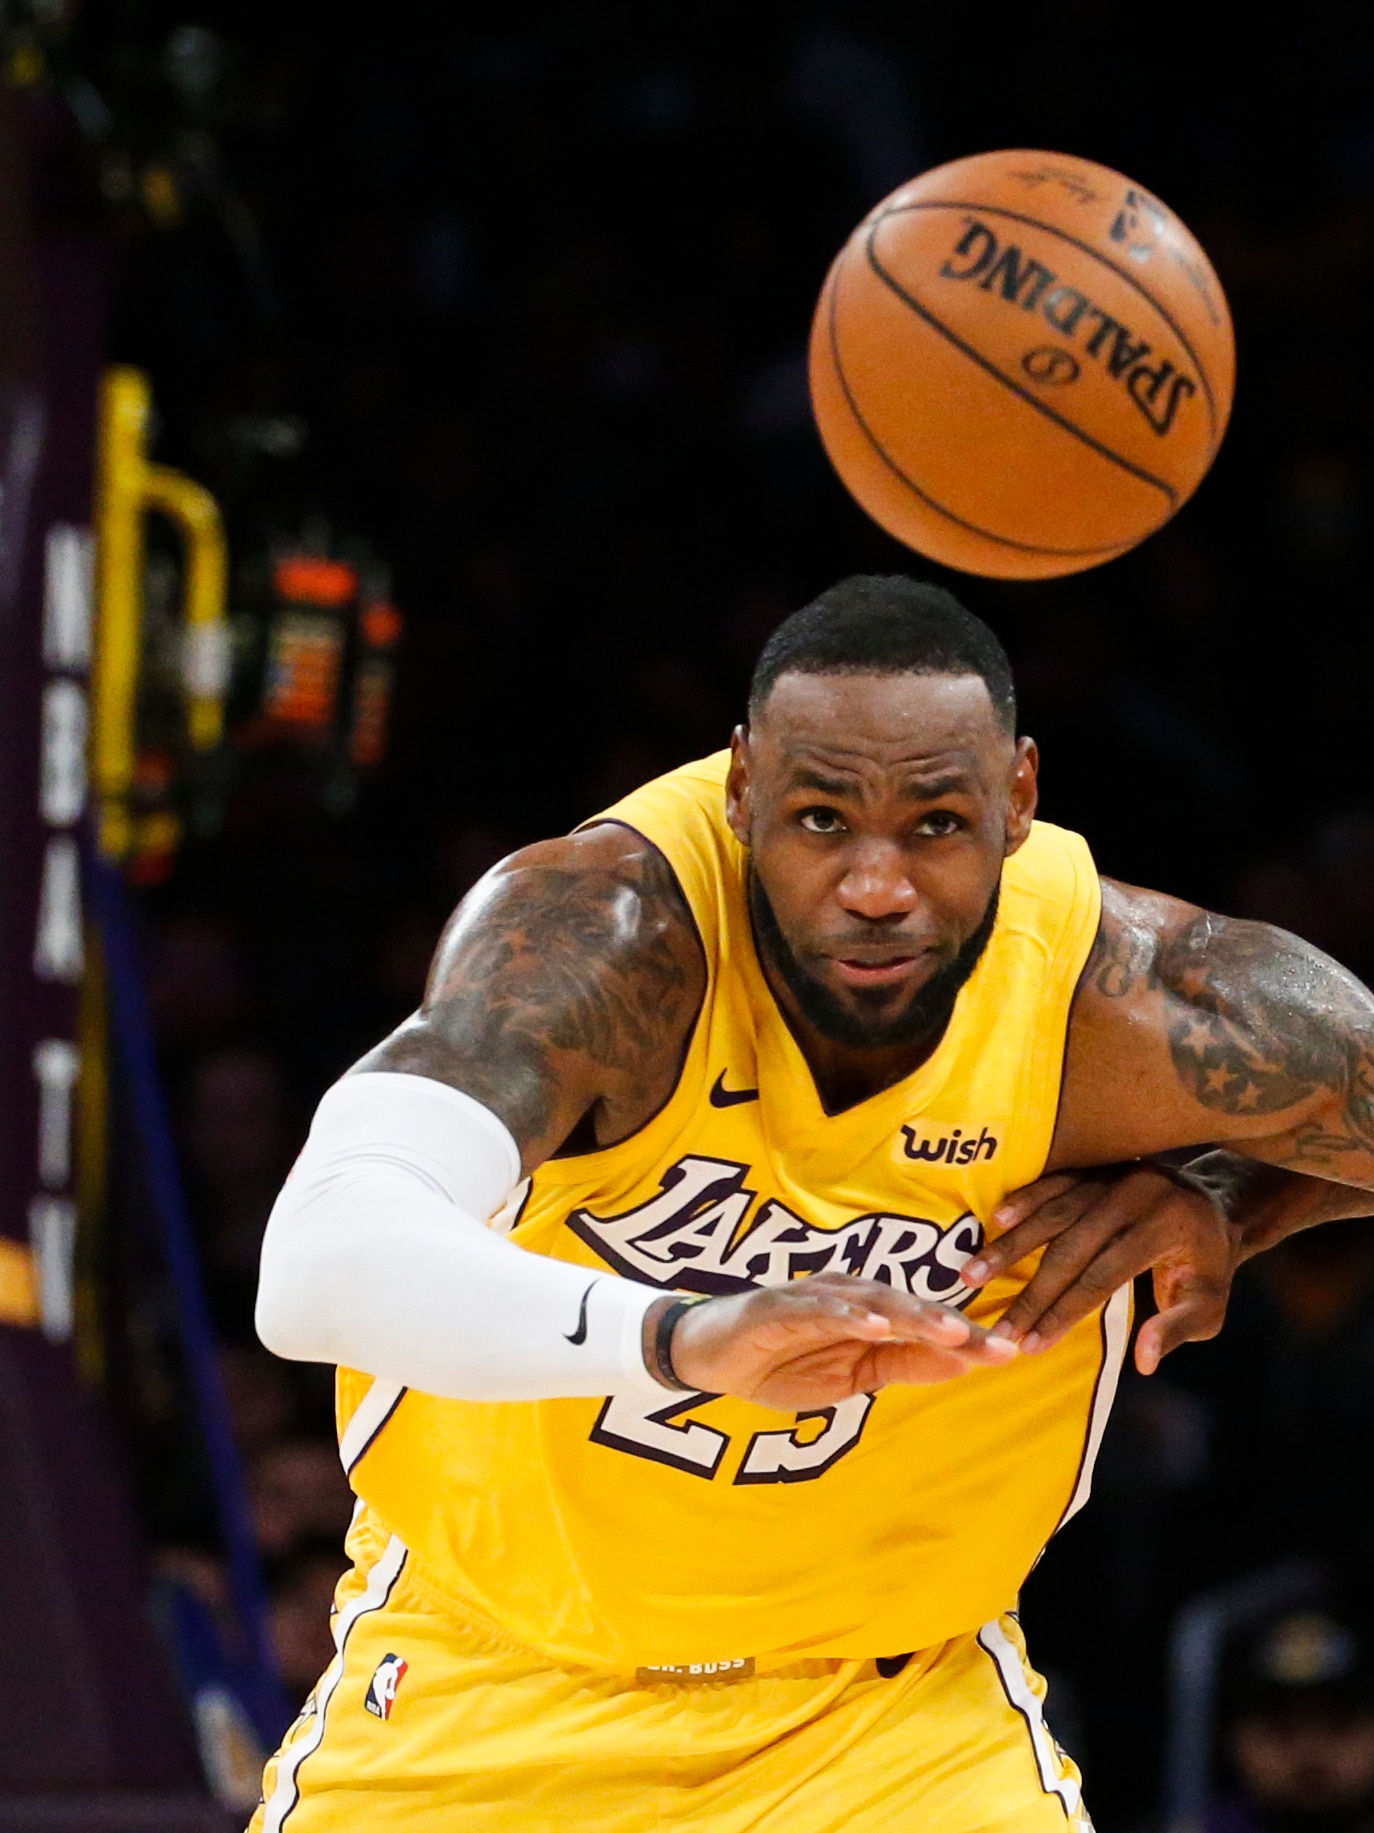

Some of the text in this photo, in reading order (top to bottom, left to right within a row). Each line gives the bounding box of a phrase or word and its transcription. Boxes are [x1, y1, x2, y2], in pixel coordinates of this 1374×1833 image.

[940, 216, 1196, 436] SPALDING
[901, 1124, 997, 1164] wish
[566, 1154, 984, 1312] LAKERS
